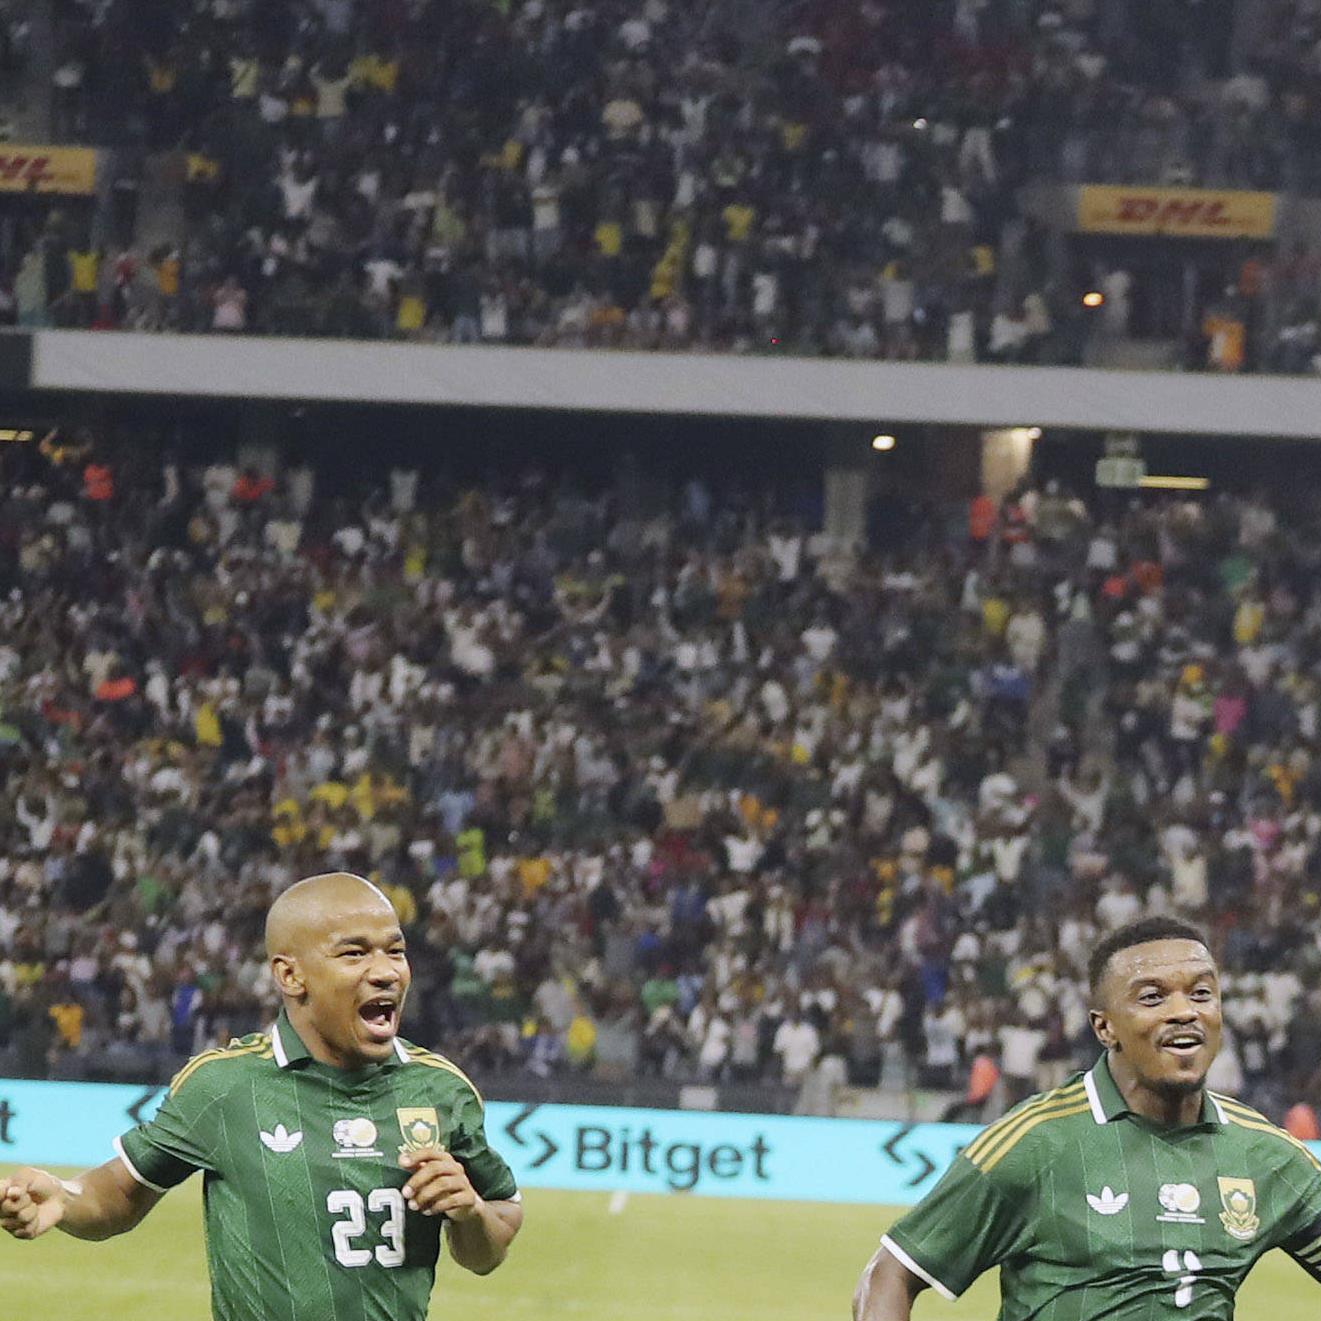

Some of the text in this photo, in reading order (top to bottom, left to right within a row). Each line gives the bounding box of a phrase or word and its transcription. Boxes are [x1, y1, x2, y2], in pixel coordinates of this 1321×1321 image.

[0, 156, 54, 180] HL
[1118, 198, 1231, 225] DHL
[574, 1126, 770, 1192] Bitget
[326, 1188, 406, 1268] 23
